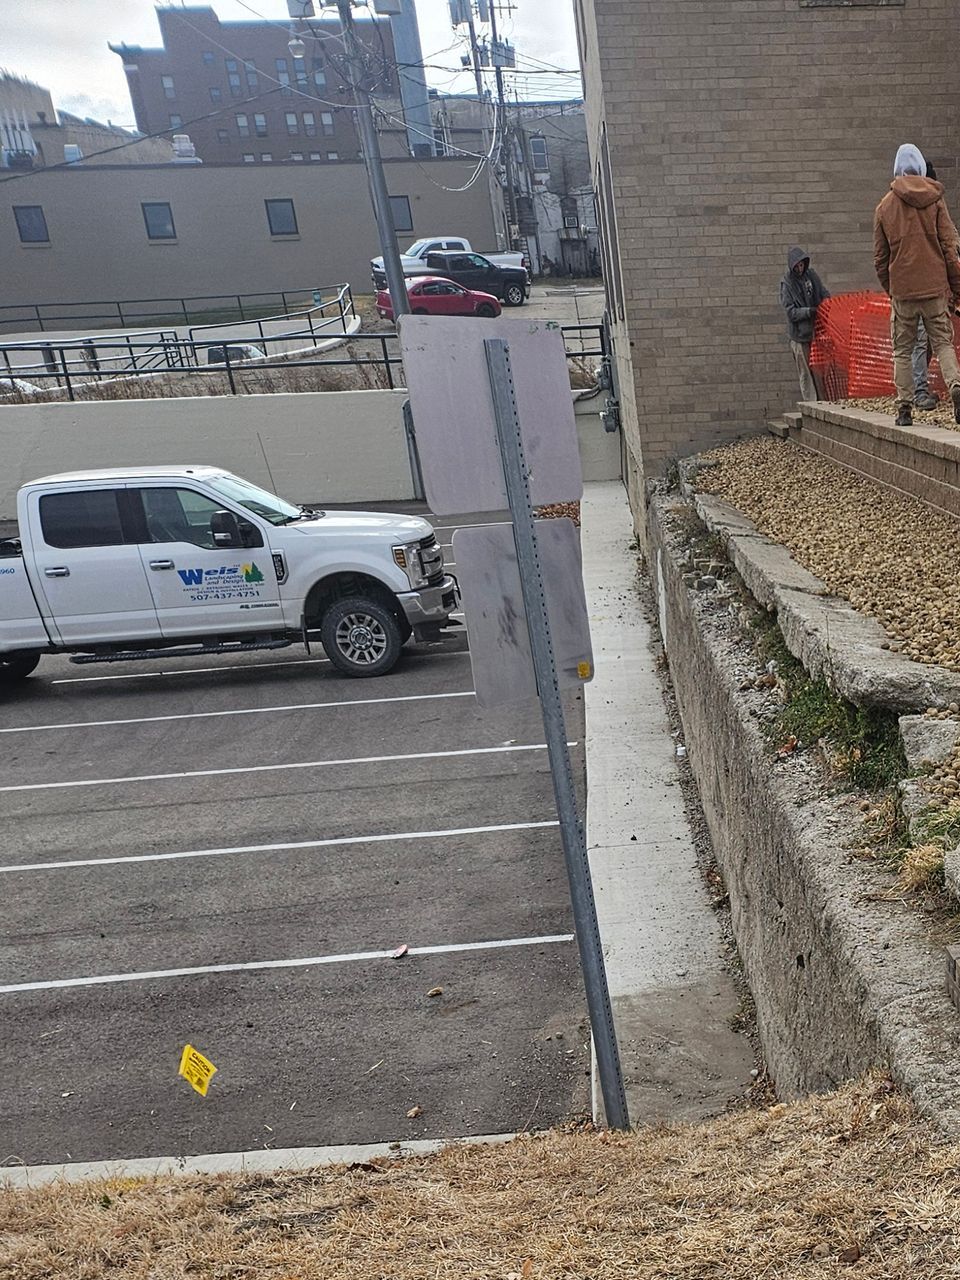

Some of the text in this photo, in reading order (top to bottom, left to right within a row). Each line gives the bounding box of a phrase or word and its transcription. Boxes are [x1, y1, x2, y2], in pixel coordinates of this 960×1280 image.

[177, 566, 239, 586] Weis
[204, 574, 244, 582] Landscaping
[190, 591, 260, 601] 507-437-4751
